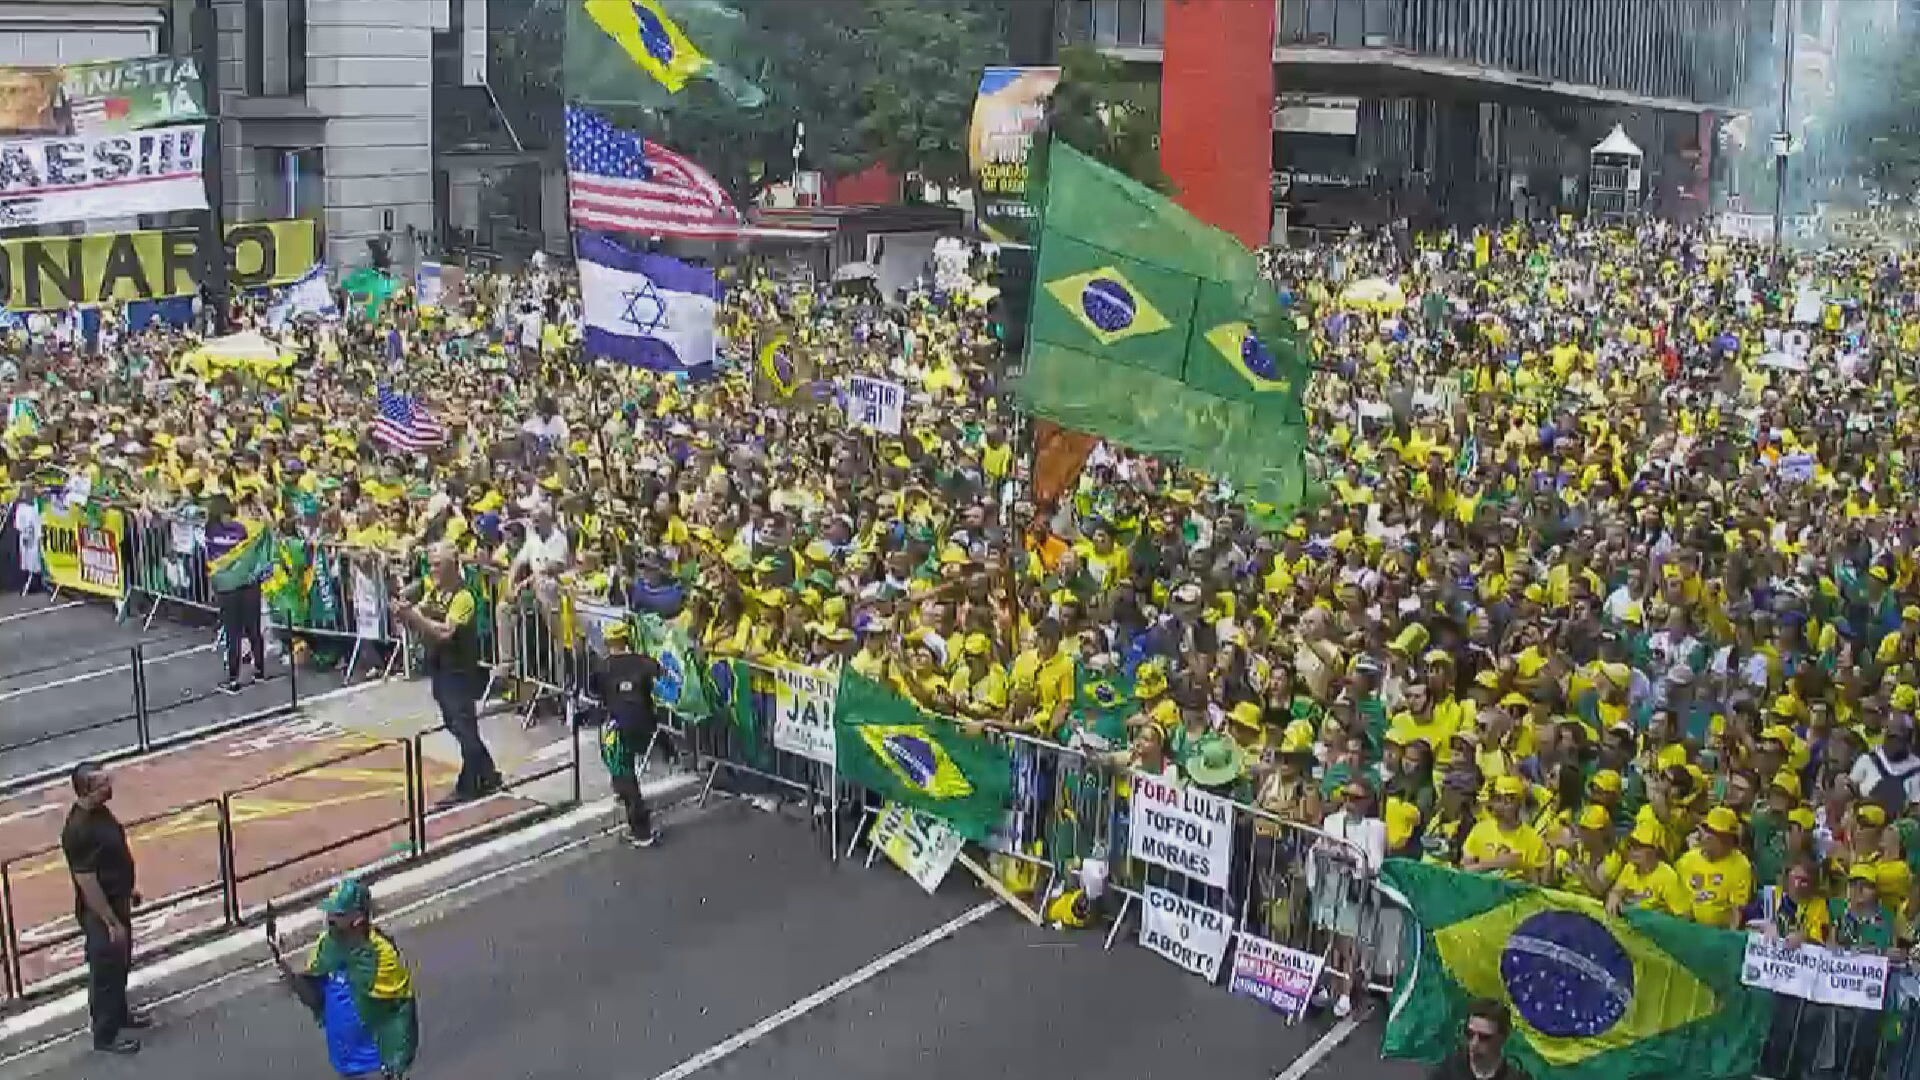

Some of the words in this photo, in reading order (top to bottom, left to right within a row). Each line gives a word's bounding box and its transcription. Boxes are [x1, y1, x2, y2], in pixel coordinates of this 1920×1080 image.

[0, 226, 277, 306] NARO
[1133, 775, 1178, 811] FORA
[1183, 781, 1227, 825] LULA
[1144, 808, 1213, 850] TOFFOLI
[1141, 835, 1211, 878] MORAES
[1147, 930, 1214, 974] ABORTO
